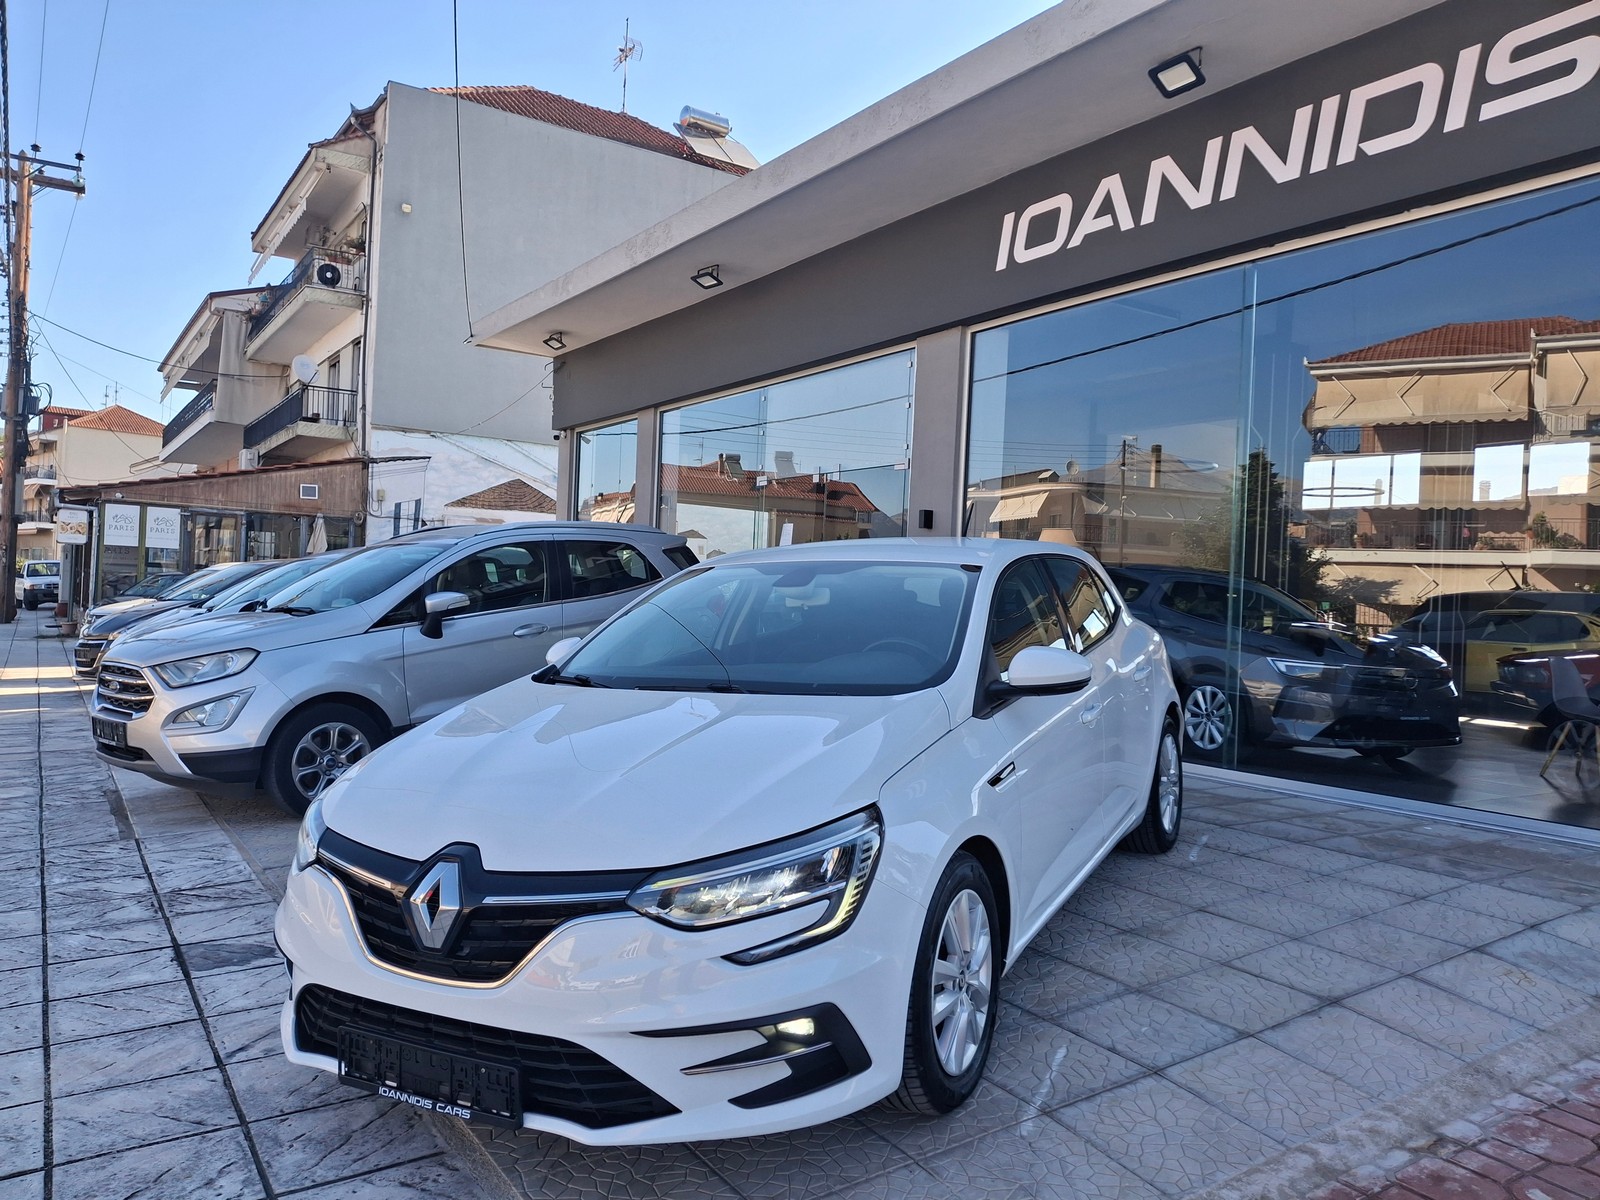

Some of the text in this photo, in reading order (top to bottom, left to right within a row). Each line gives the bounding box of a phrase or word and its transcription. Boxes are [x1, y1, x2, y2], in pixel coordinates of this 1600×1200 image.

[995, 0, 1600, 272] IOANNIDIS
[108, 524, 135, 532] PARIS
[149, 526, 176, 535] PARIS
[378, 1086, 471, 1119] IOANNIDIS CARS
